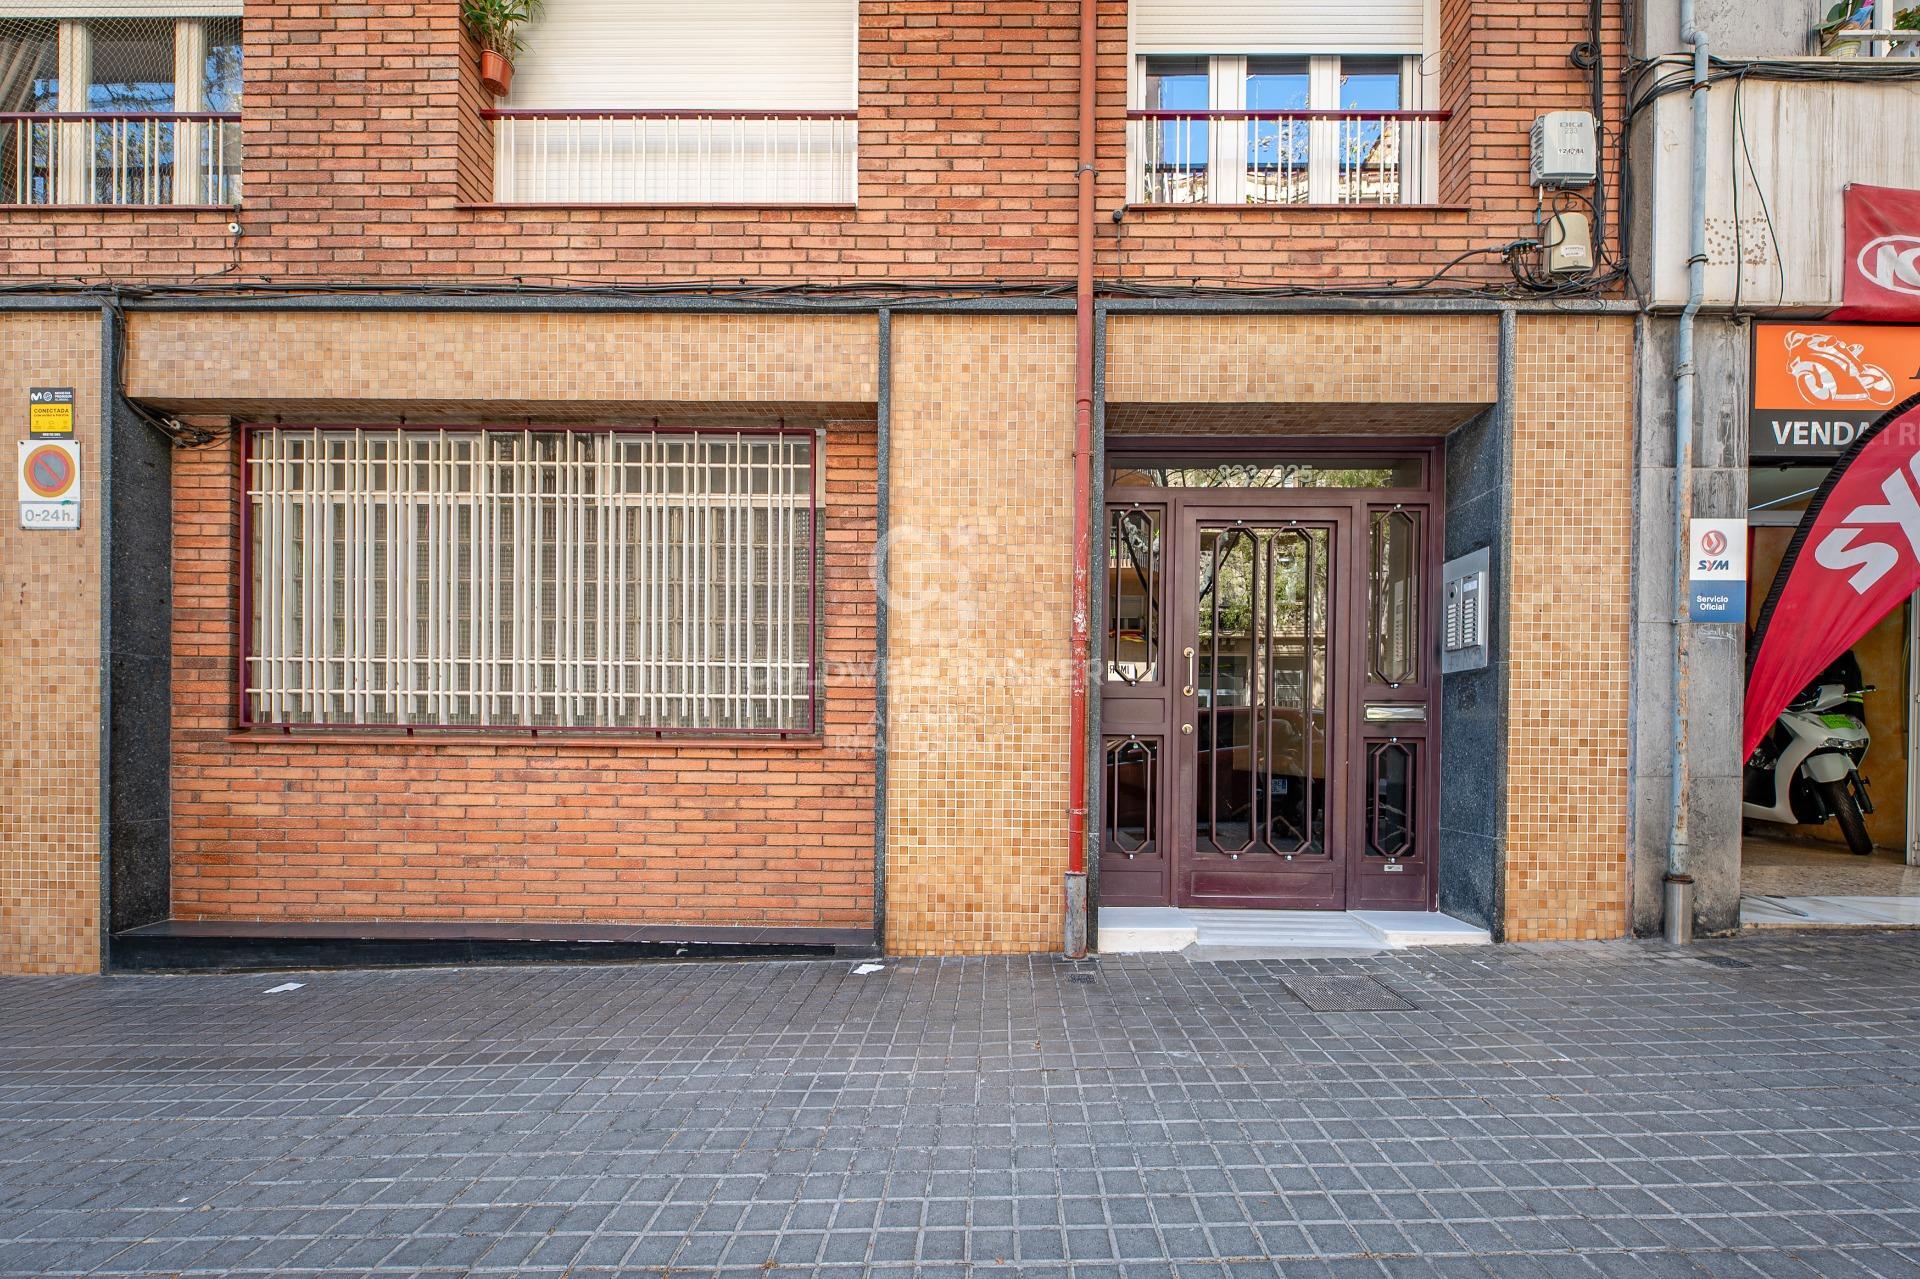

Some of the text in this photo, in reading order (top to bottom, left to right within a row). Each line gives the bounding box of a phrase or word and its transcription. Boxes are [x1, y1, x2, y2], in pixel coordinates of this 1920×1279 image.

[1697, 559, 1730, 571] SYM
[1696, 595, 1729, 603] Servicio
[1699, 603, 1725, 611] Oficial
